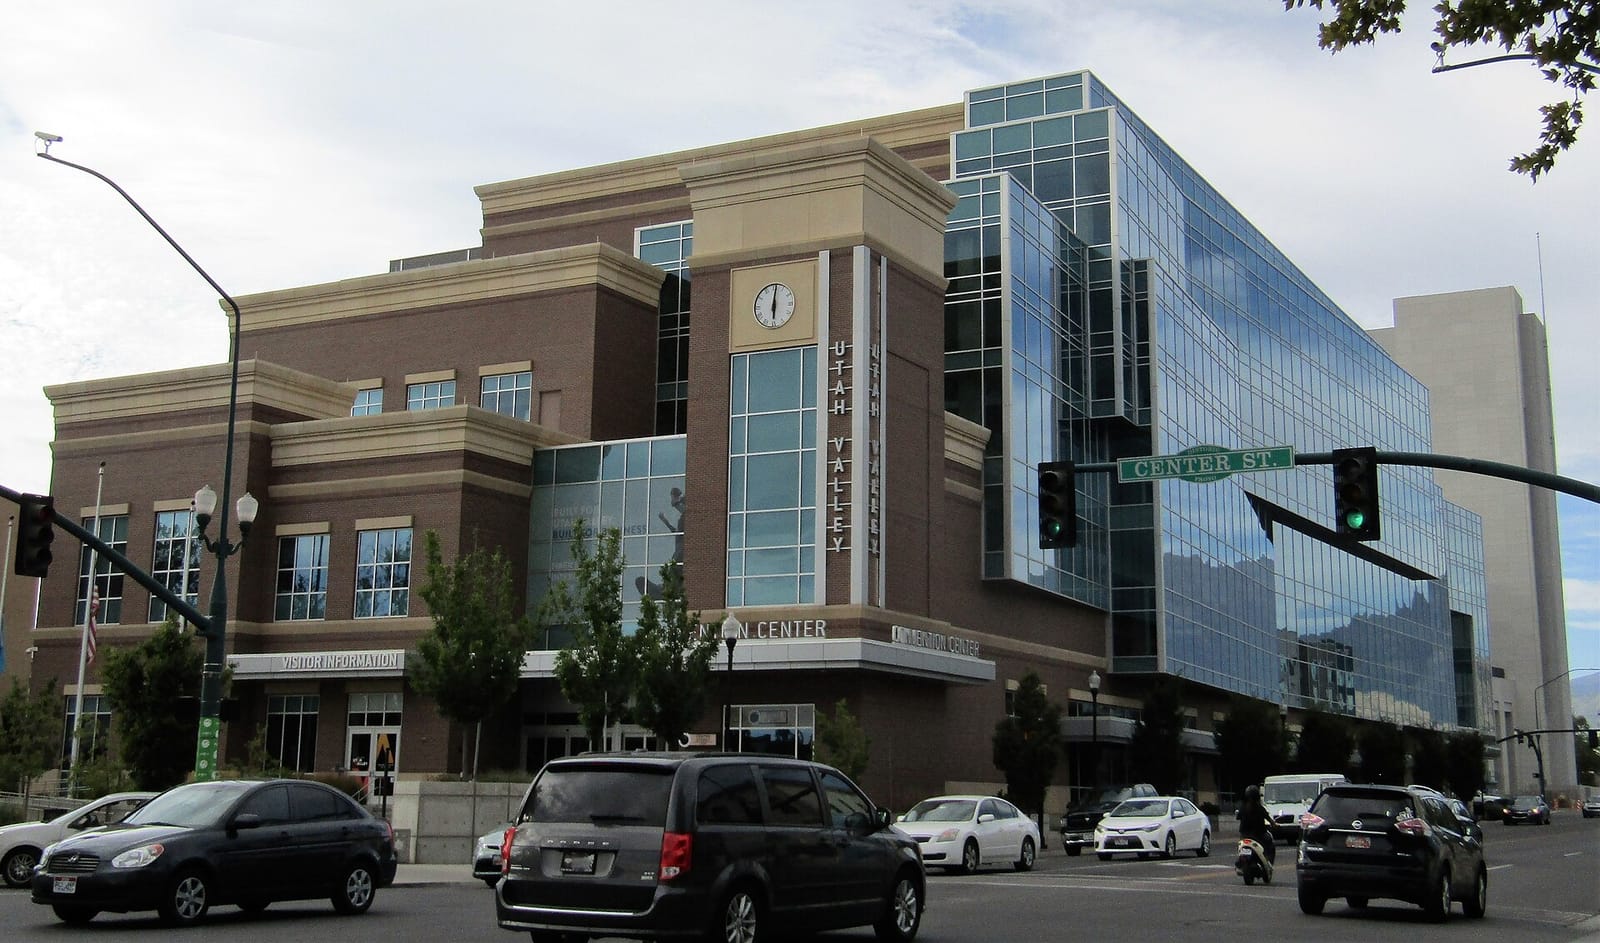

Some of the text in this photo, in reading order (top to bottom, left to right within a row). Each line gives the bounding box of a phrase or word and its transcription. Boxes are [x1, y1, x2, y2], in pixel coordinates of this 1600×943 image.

[833, 341, 846, 552] UTAH VALLEY
[1134, 452, 1277, 477] CENTER ST.
[757, 619, 827, 639] CENTER
[949, 636, 980, 656] CENTER
[284, 653, 398, 669] VISITOR INFORMATION
